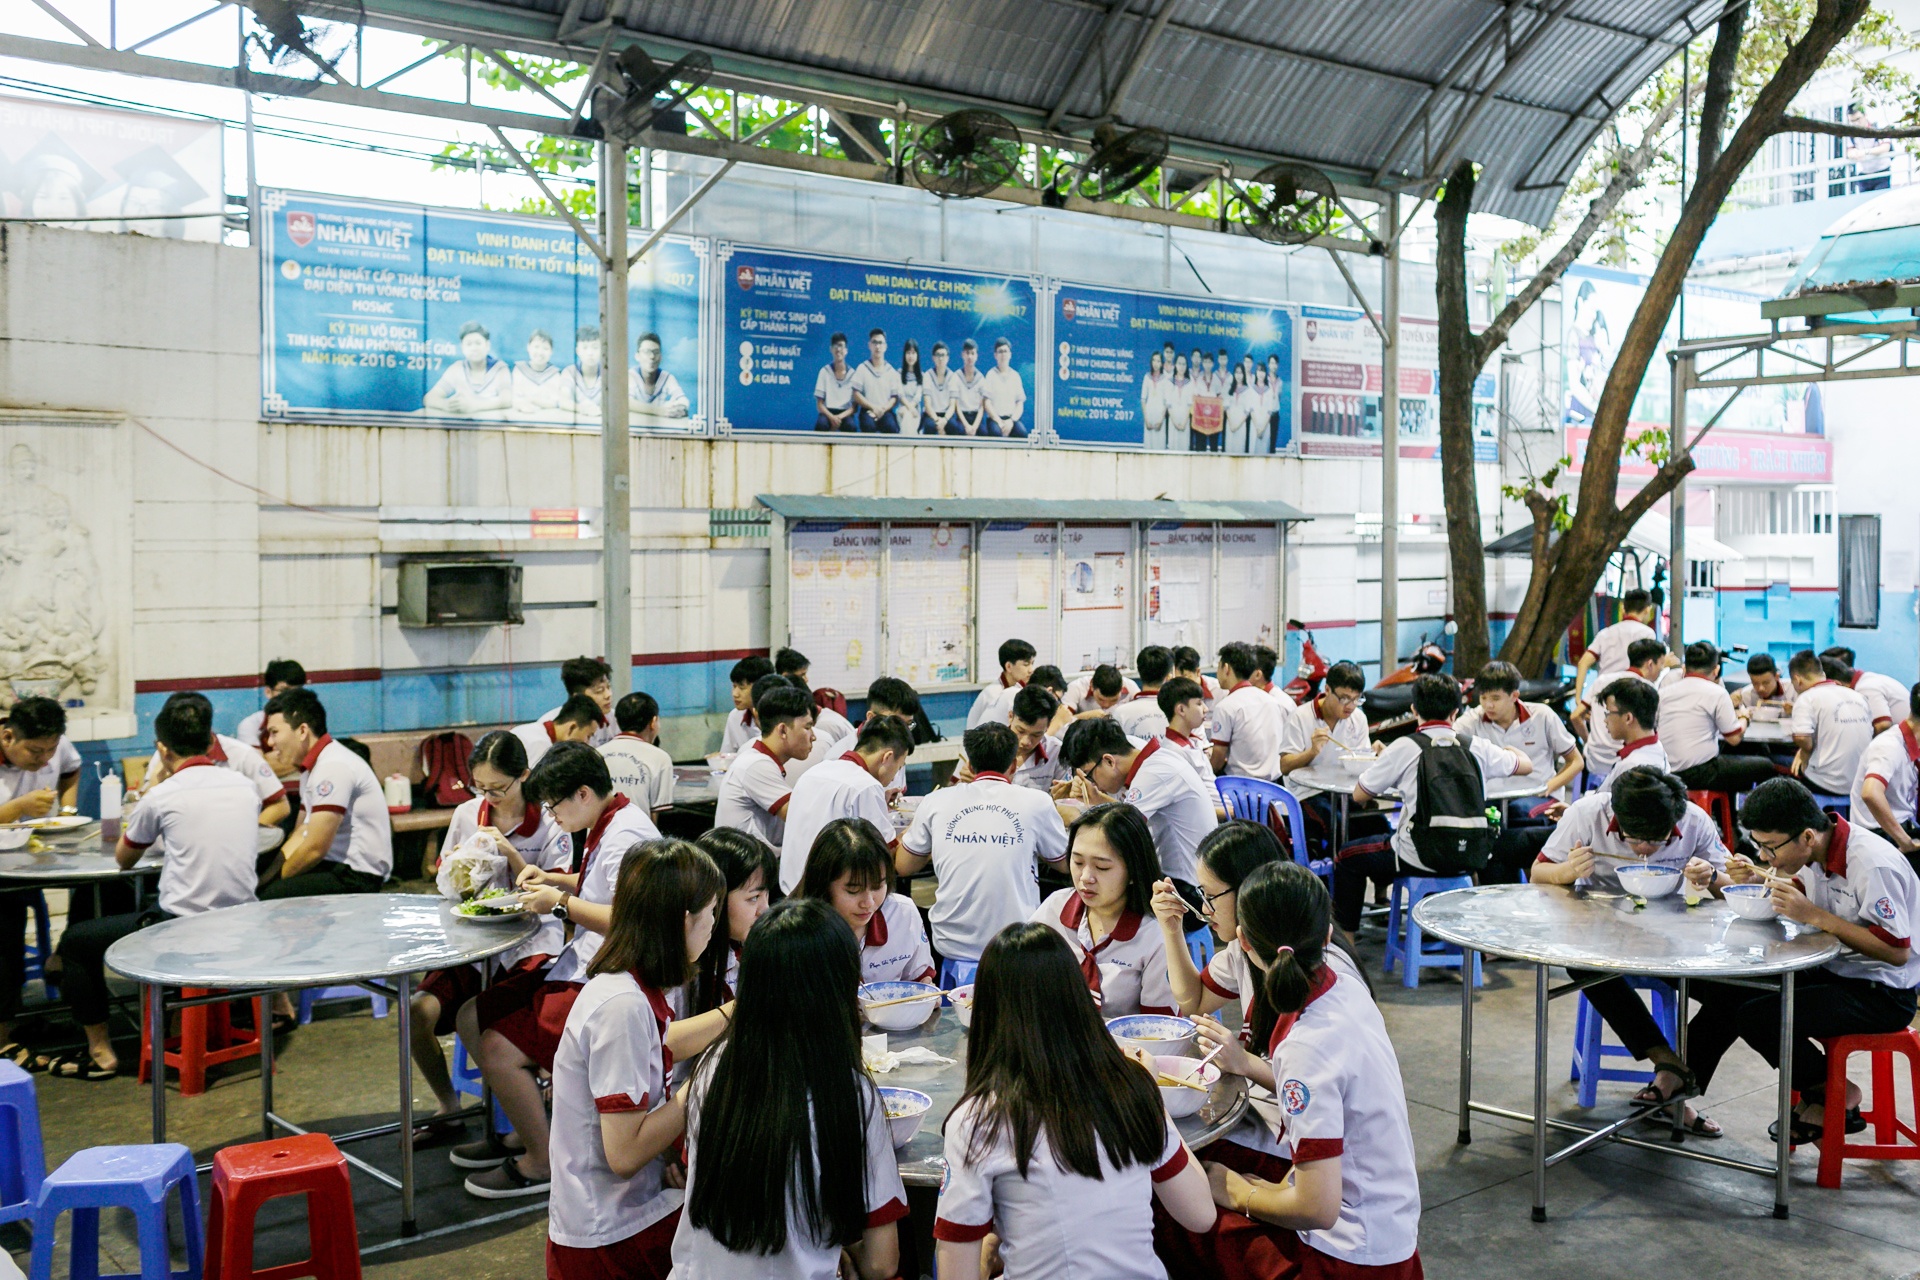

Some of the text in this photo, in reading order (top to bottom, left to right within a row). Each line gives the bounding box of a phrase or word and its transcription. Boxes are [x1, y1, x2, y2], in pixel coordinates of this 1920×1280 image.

[317, 222, 413, 252] NHÂN VIỆT
[476, 231, 510, 249] VINH
[511, 234, 550, 252] DANH
[551, 236, 576, 255] CÁC
[427, 246, 595, 277] ĐẠT THÀNH TÍCH TỐT NĂM
[303, 264, 462, 290] 4 GIẢI NHẤT CẤP THÀNH PHỐ
[663, 272, 695, 287] 2017
[754, 273, 812, 293] NHÂN VIỆT
[865, 273, 890, 288] VINH
[891, 276, 918, 290] DANH
[920, 275, 938, 292] CÁC
[938, 281, 953, 293] EM
[953, 283, 973, 296] HỌC
[303, 279, 461, 303] ĐẠI DIỆN THI VÒNG QUỐC GIA
[352, 300, 394, 314] MOSWC
[829, 288, 850, 302] ĐẠT
[852, 288, 887, 304] THÀNH
[888, 291, 909, 306] TÍCH
[911, 292, 930, 308] TỐT
[930, 295, 952, 310] NĂM
[953, 299, 973, 313] HỌC
[754, 309, 768, 319] THI
[769, 310, 786, 323] HỌC
[788, 311, 808, 323] SINH
[1076, 303, 1100, 319] NHÂN
[1101, 306, 1120, 322] VIỆT
[1158, 304, 1177, 316] VINH
[1178, 306, 1199, 318] DANH
[1200, 307, 1214, 321] CÁC
[348, 323, 368, 336] THI
[370, 322, 388, 337] VÔ
[389, 326, 418, 341] ĐỊCH
[740, 317, 808, 335] CẤP THÀNH PHỐ
[1131, 317, 1147, 331] ĐẠT
[1148, 318, 1174, 332] THÀNH
[1175, 320, 1191, 333] TÍCH
[1193, 322, 1207, 335] TỐT
[1208, 324, 1225, 337] NĂM
[286, 333, 308, 346] TIN
[310, 335, 336, 351] HỌC
[337, 333, 364, 350] VĂN
[365, 336, 408, 354] PHÒNG
[408, 337, 432, 354] THẾ
[755, 345, 760, 354] 1
[301, 348, 331, 365] NĂM
[332, 352, 358, 368] HỌC
[359, 352, 397, 369] 2016
[406, 356, 443, 372] 2017
[755, 360, 760, 368] 1
[754, 373, 761, 382] 4
[1091, 396, 1124, 408] OLYMPIC
[1088, 408, 1110, 420] 2016
[1114, 410, 1135, 421] 2017
[833, 533, 859, 547] BẢNG
[1033, 532, 1049, 544] GÓC
[1068, 531, 1084, 545] TẬP
[1168, 532, 1189, 544] BẢNG
[1232, 533, 1257, 544] CHUNG
[619, 774, 640, 787] VIỆT
[945, 804, 1025, 844] TRƯỜNG TRUNG HỌC PHỔ THÔNG
[953, 831, 1016, 848] NHÂN VIỆT
